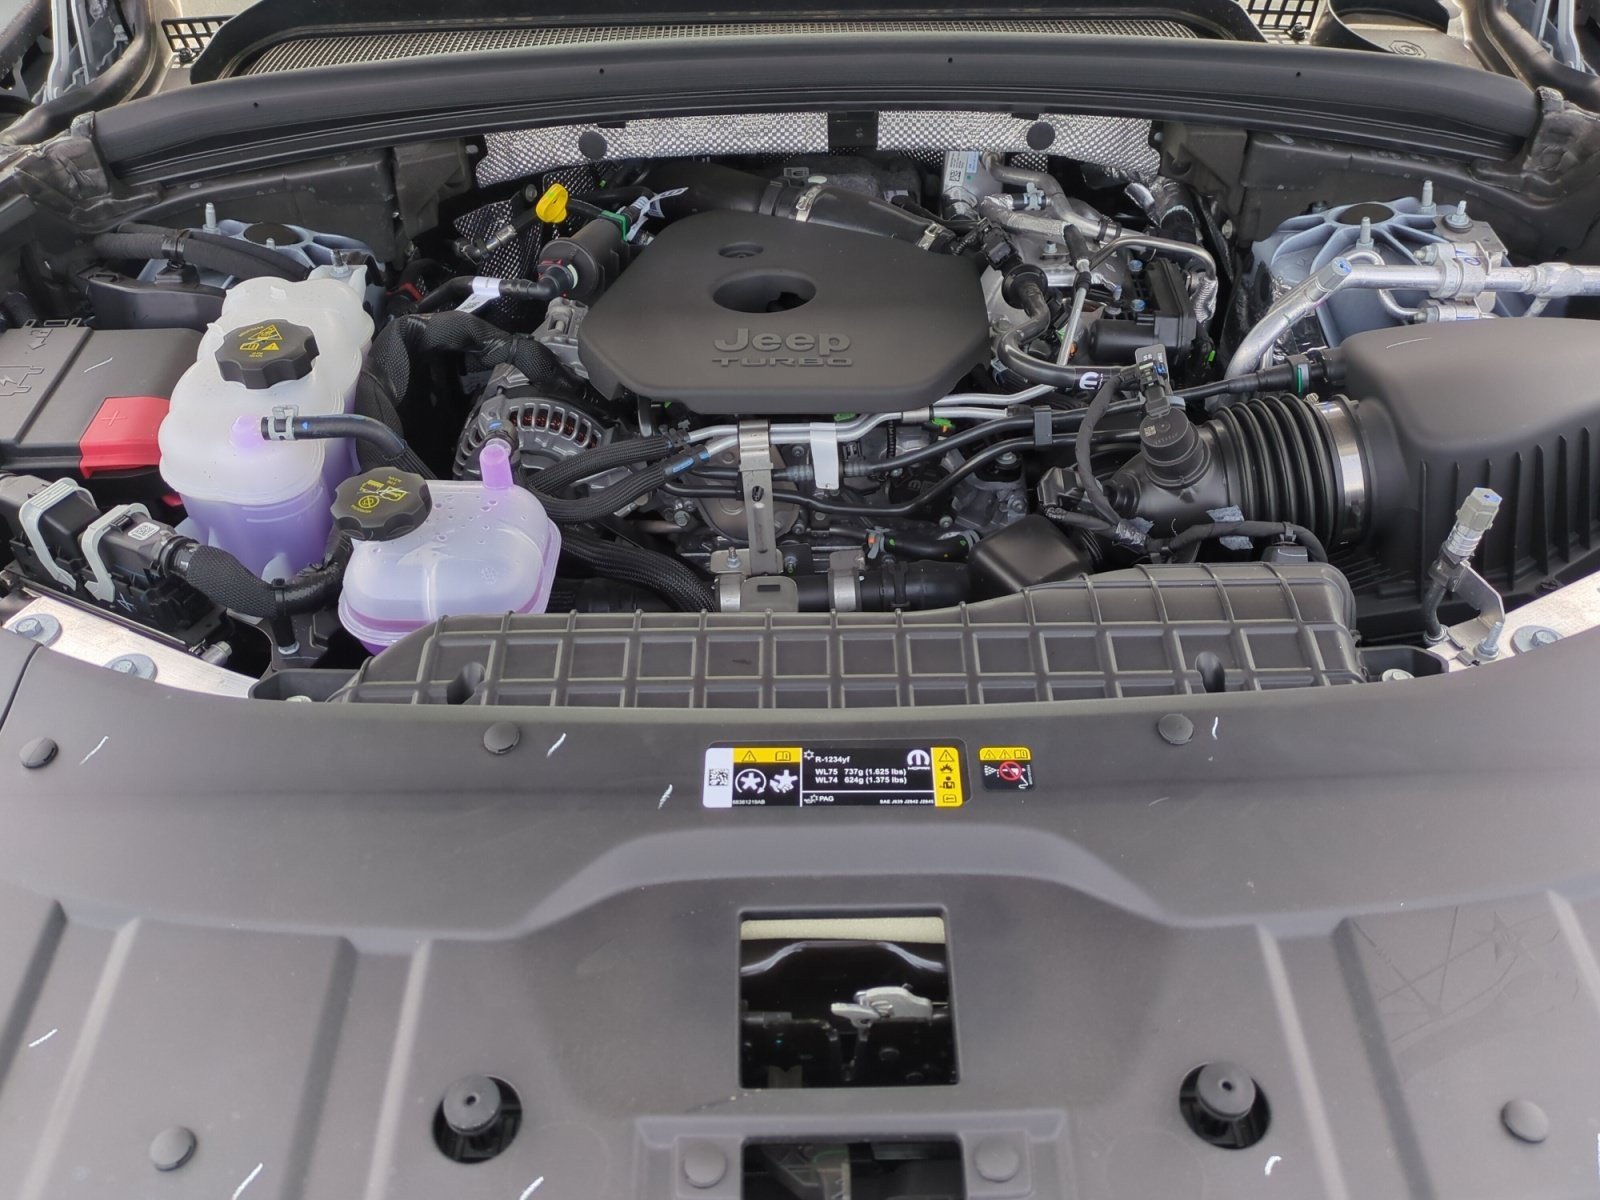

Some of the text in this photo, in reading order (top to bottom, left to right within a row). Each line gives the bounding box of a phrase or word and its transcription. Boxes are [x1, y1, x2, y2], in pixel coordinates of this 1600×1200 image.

[714, 328, 851, 357] Jeep
[712, 356, 852, 367] TURBO
[815, 756, 850, 764] R-1234yf
